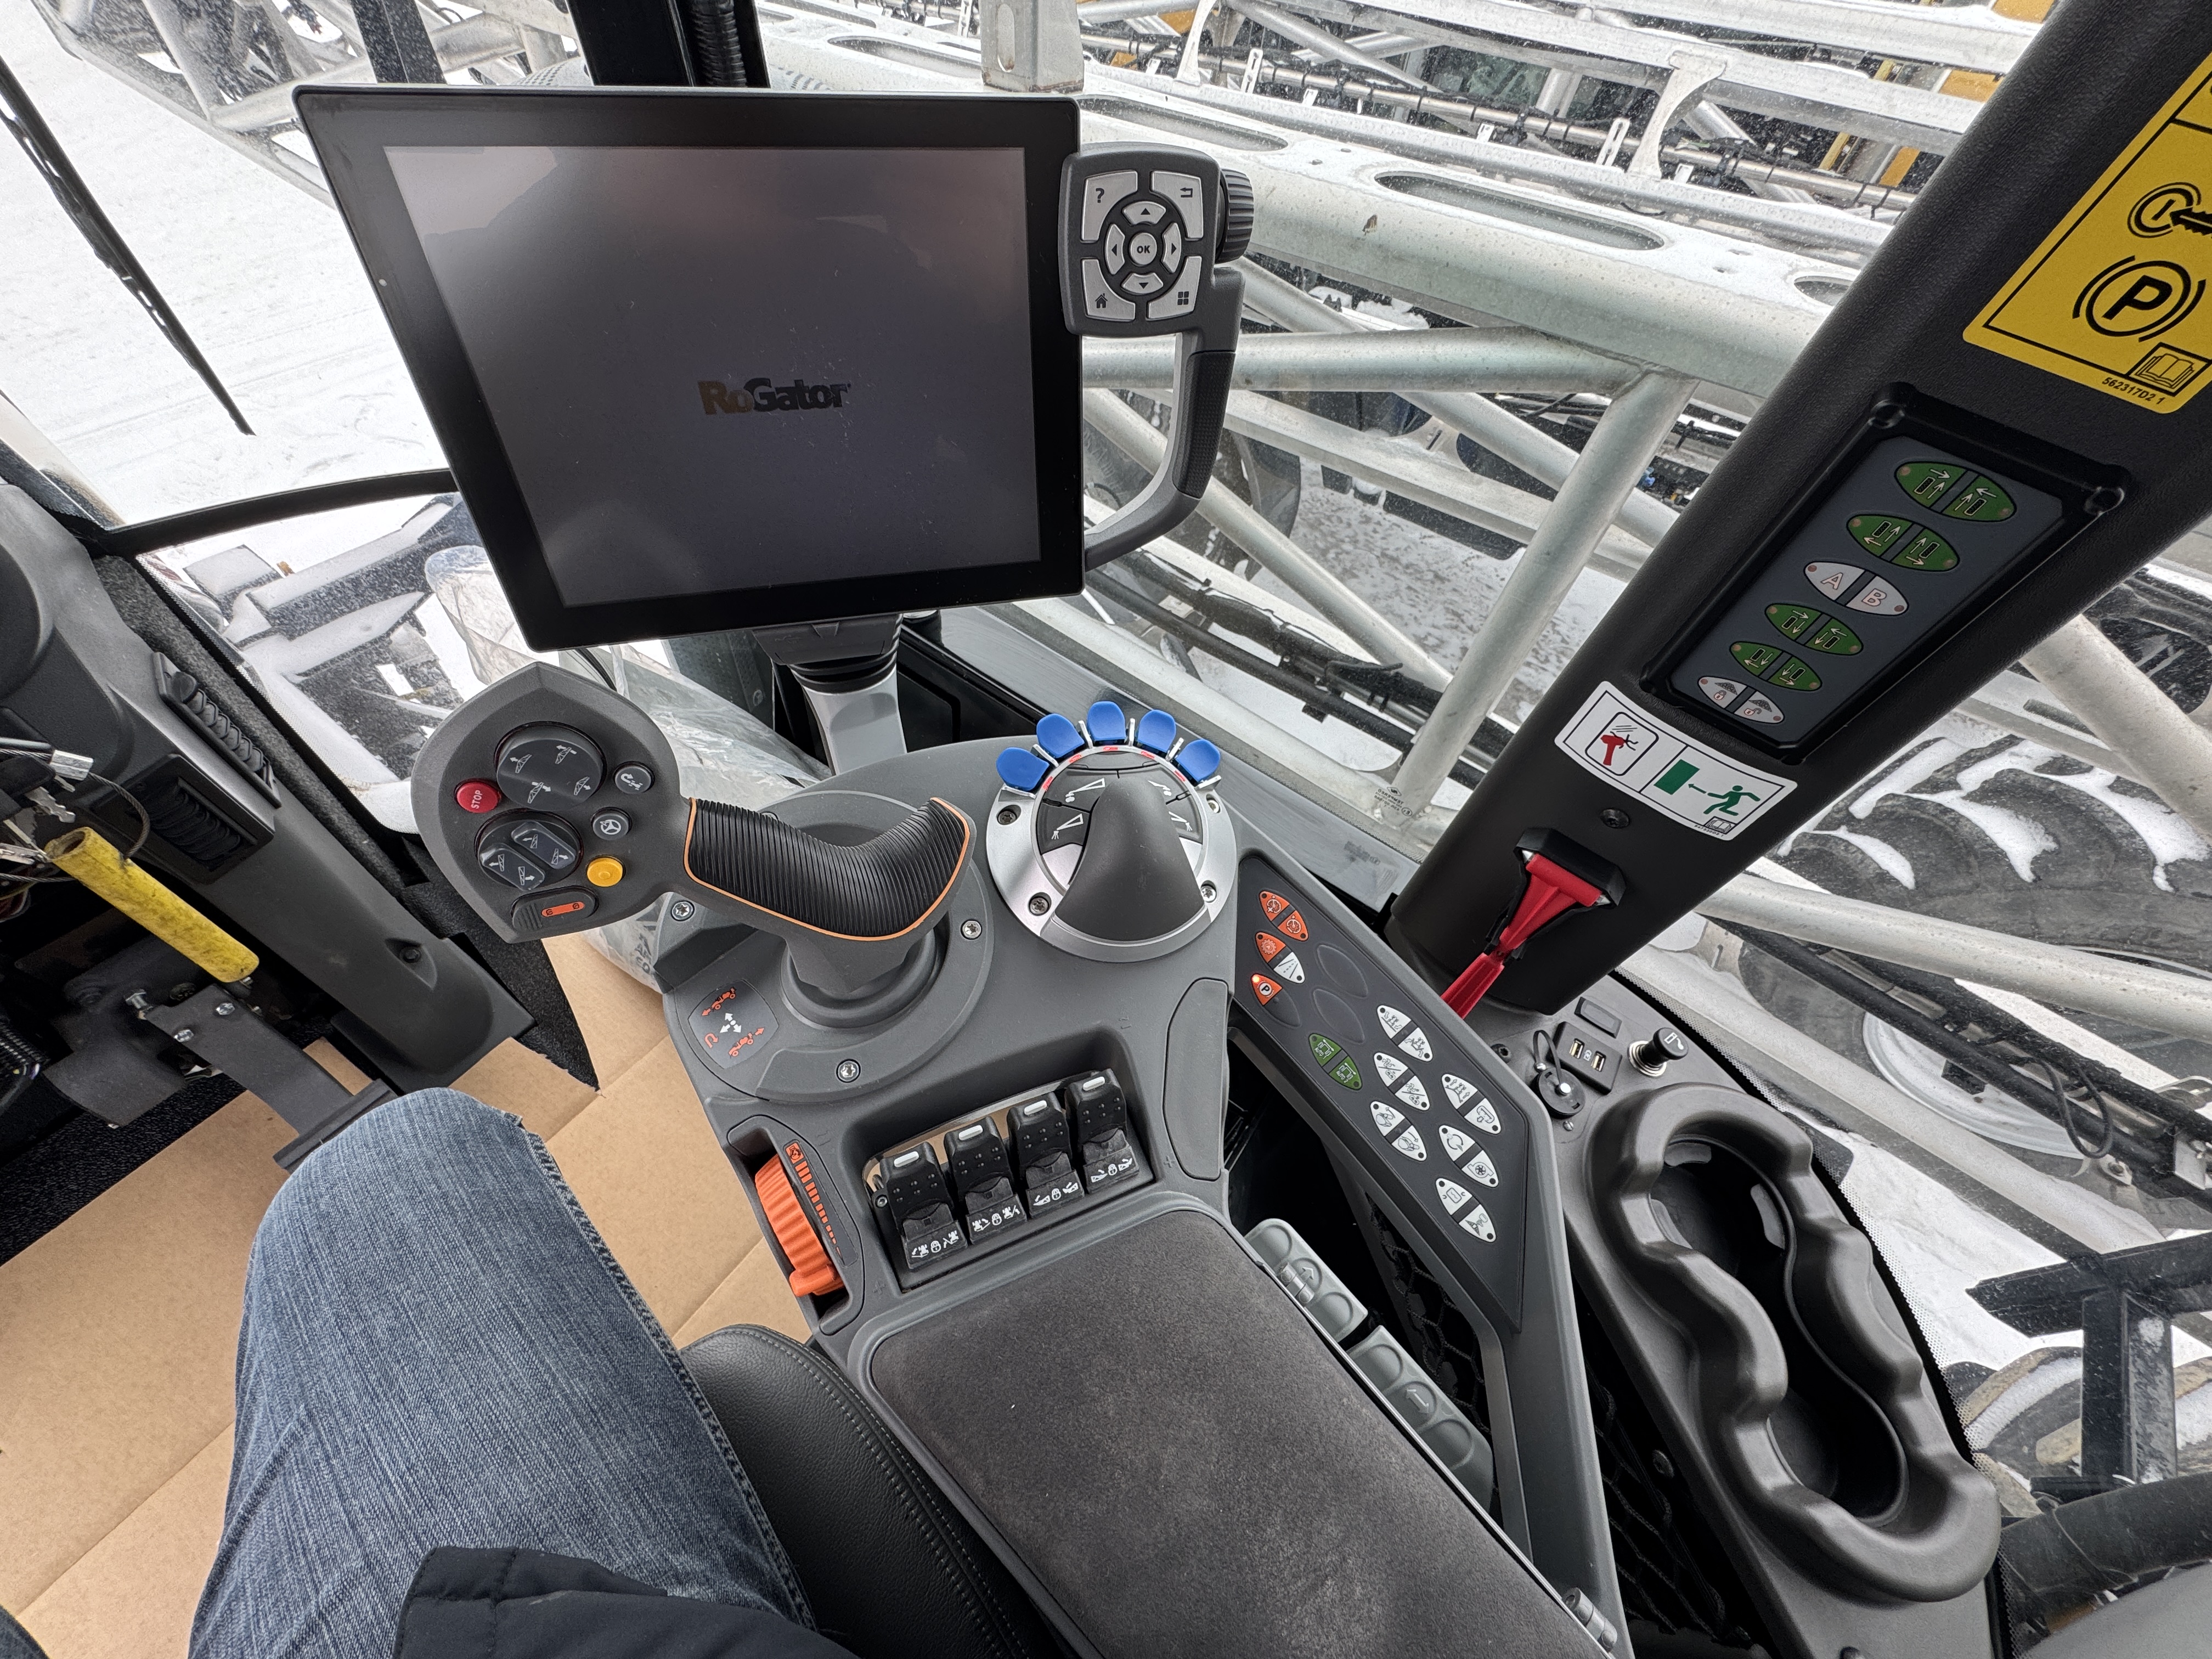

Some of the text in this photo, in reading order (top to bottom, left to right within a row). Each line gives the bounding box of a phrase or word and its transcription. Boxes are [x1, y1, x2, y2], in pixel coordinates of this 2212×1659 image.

[1137, 245, 1150, 254] OK
[2101, 274, 2172, 320] P
[698, 377, 850, 415] RoGator
[2102, 377, 2156, 402] 562317D2
[1820, 572, 1843, 590] A
[1861, 588, 1887, 607] B
[471, 789, 483, 809] STOP
[1314, 1047, 1324, 1057] AUTO
[1336, 1070, 1346, 1080] AUTO
